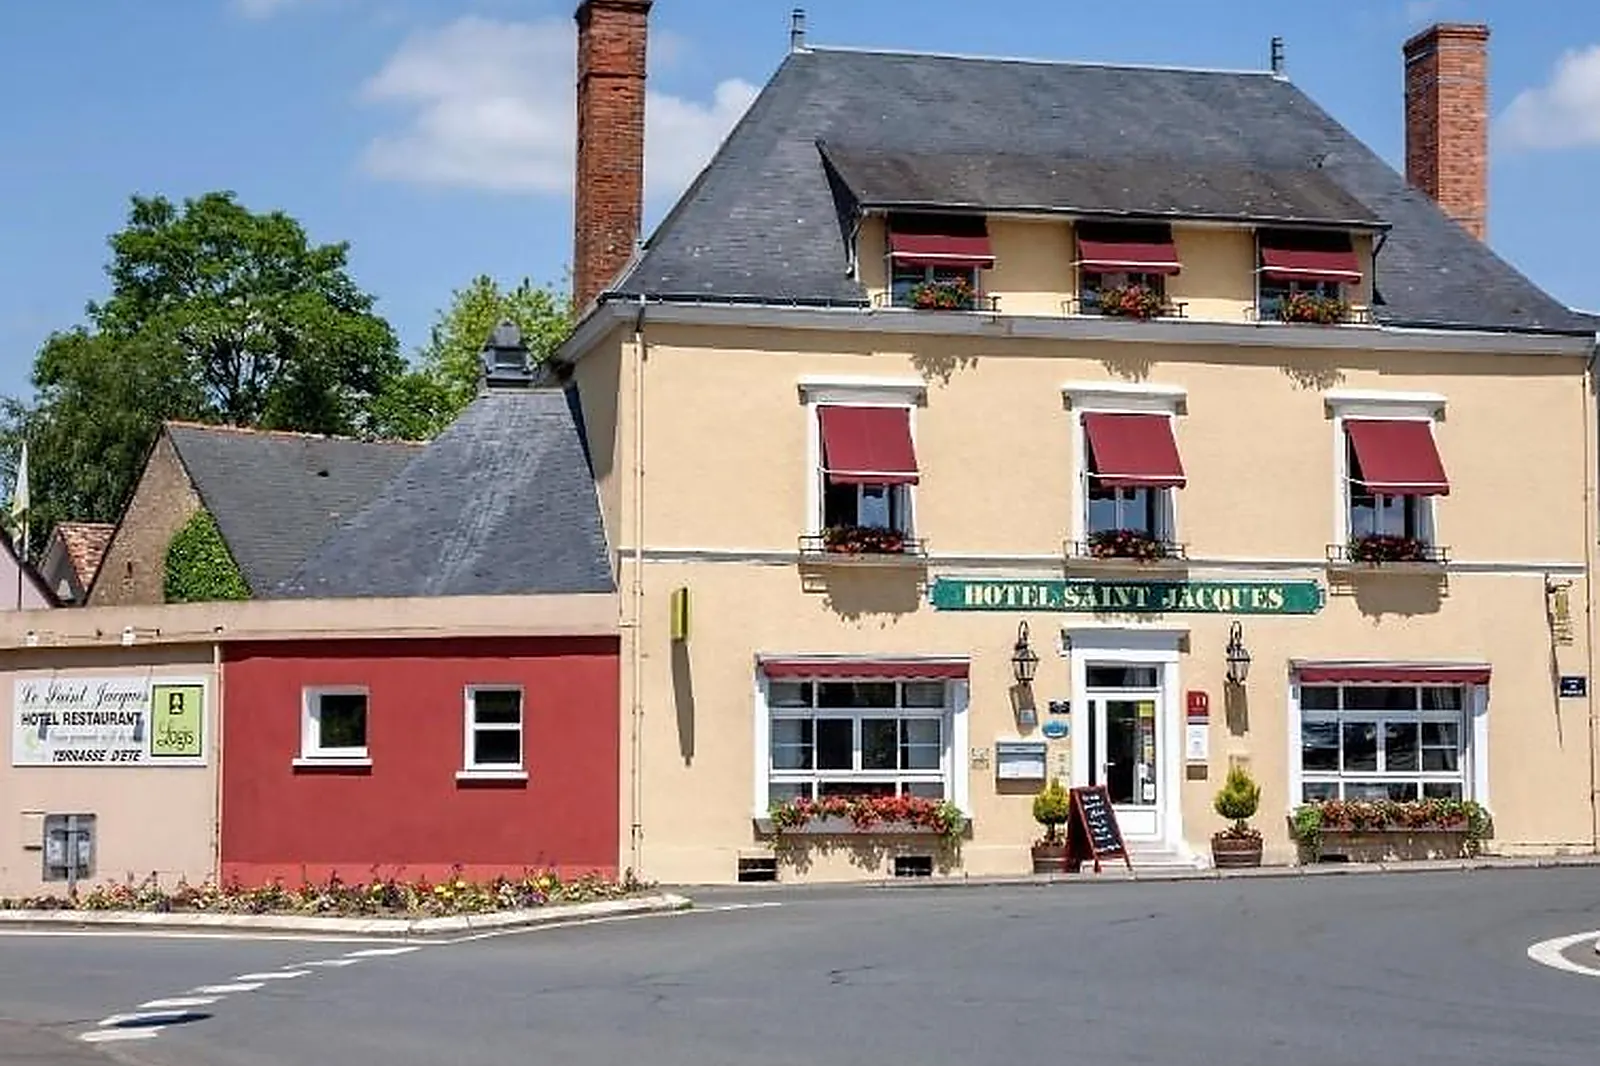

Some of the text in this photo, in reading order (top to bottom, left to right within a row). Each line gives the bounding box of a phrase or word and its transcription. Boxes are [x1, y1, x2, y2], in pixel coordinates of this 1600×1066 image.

[964, 583, 1284, 611] HOTEL SAINT JACQUES
[46, 682, 88, 705] Saint
[95, 681, 148, 708] Jacques
[21, 711, 143, 726] HOTEL RESTAURANT
[52, 749, 105, 762] TERRASSE
